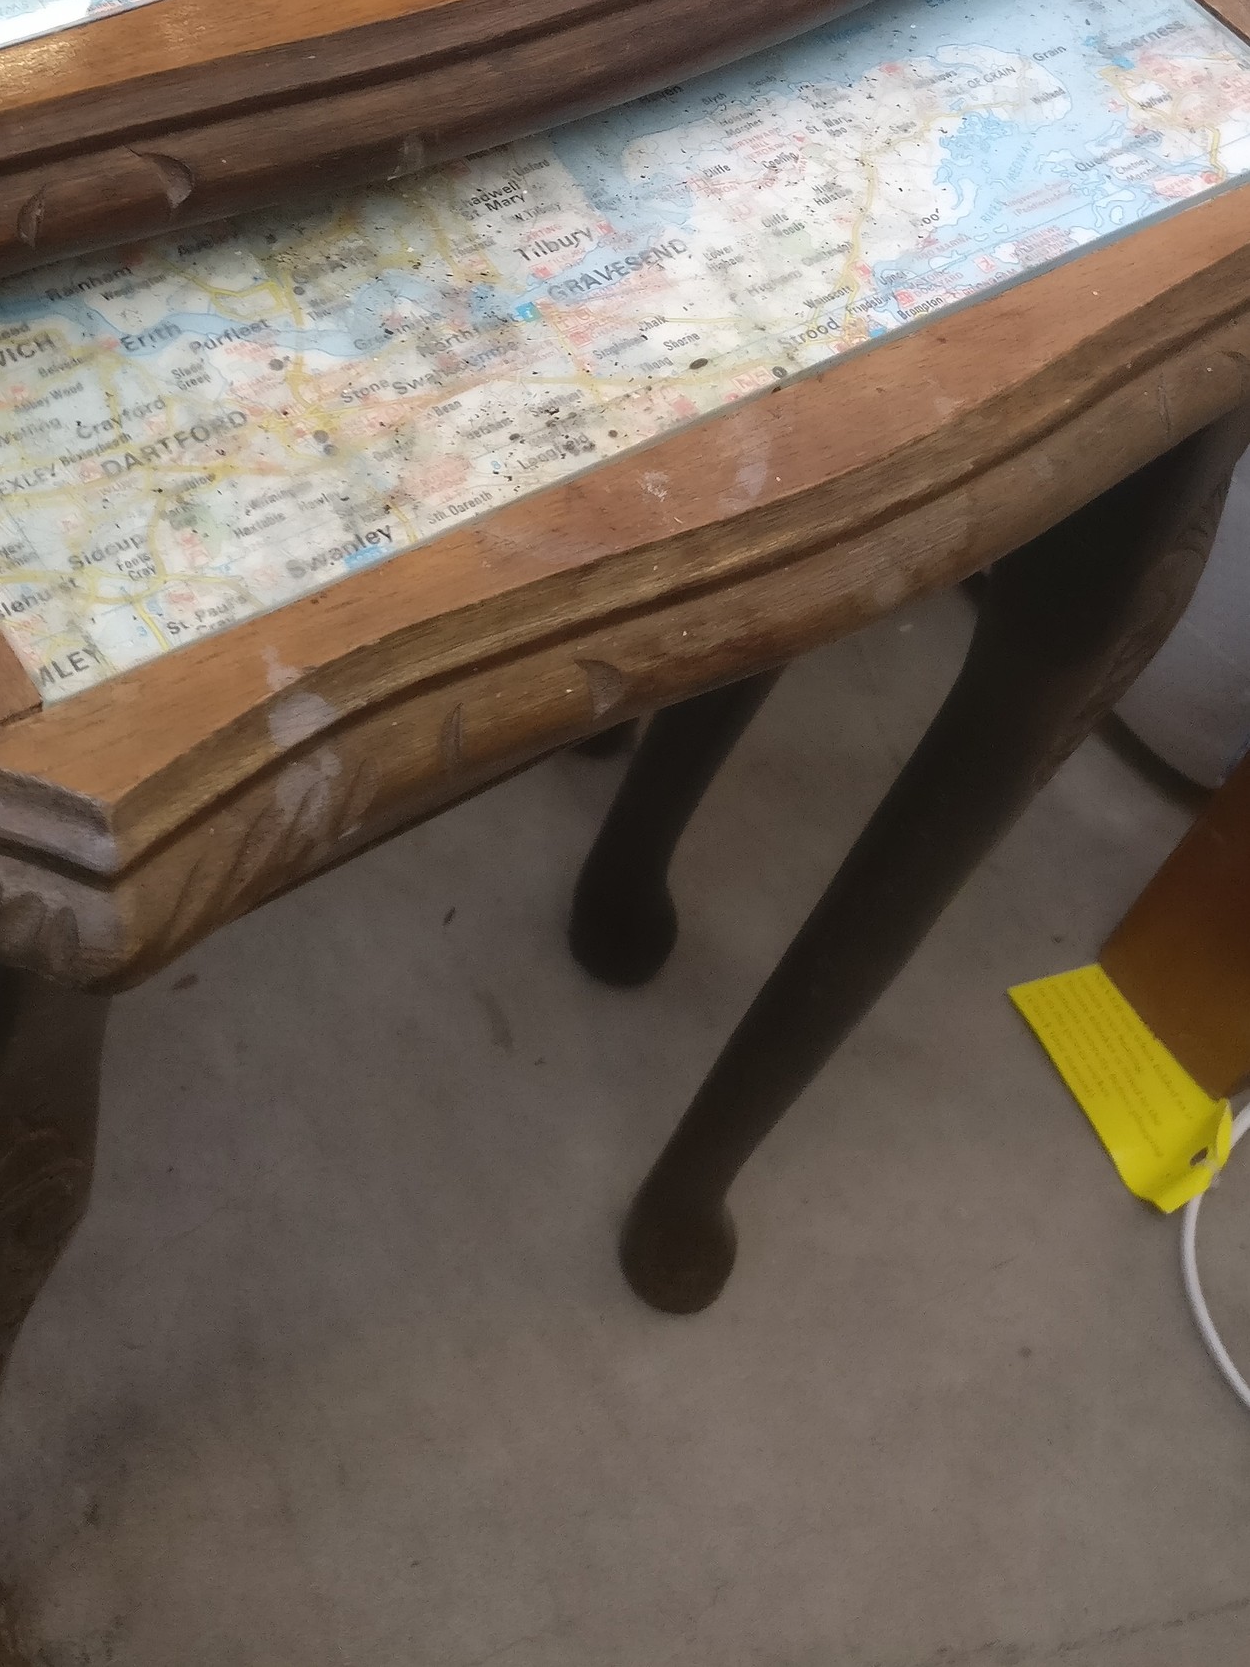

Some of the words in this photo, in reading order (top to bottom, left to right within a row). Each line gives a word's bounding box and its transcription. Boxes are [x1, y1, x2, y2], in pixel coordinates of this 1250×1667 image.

[1030, 43, 1068, 63] Grain
[513, 223, 596, 266] Tilbury
[547, 237, 689, 302] GRAVESEND
[897, 294, 945, 321] Brompton
[119, 319, 182, 353] Erith
[188, 315, 272, 355] Purfleet
[778, 317, 841, 351] Strood
[339, 375, 392, 404] Stone
[74, 395, 168, 440] Crayford
[99, 408, 251, 479] DARTFORD
[66, 529, 145, 571] Sidcup
[285, 522, 396, 581] Swanley
